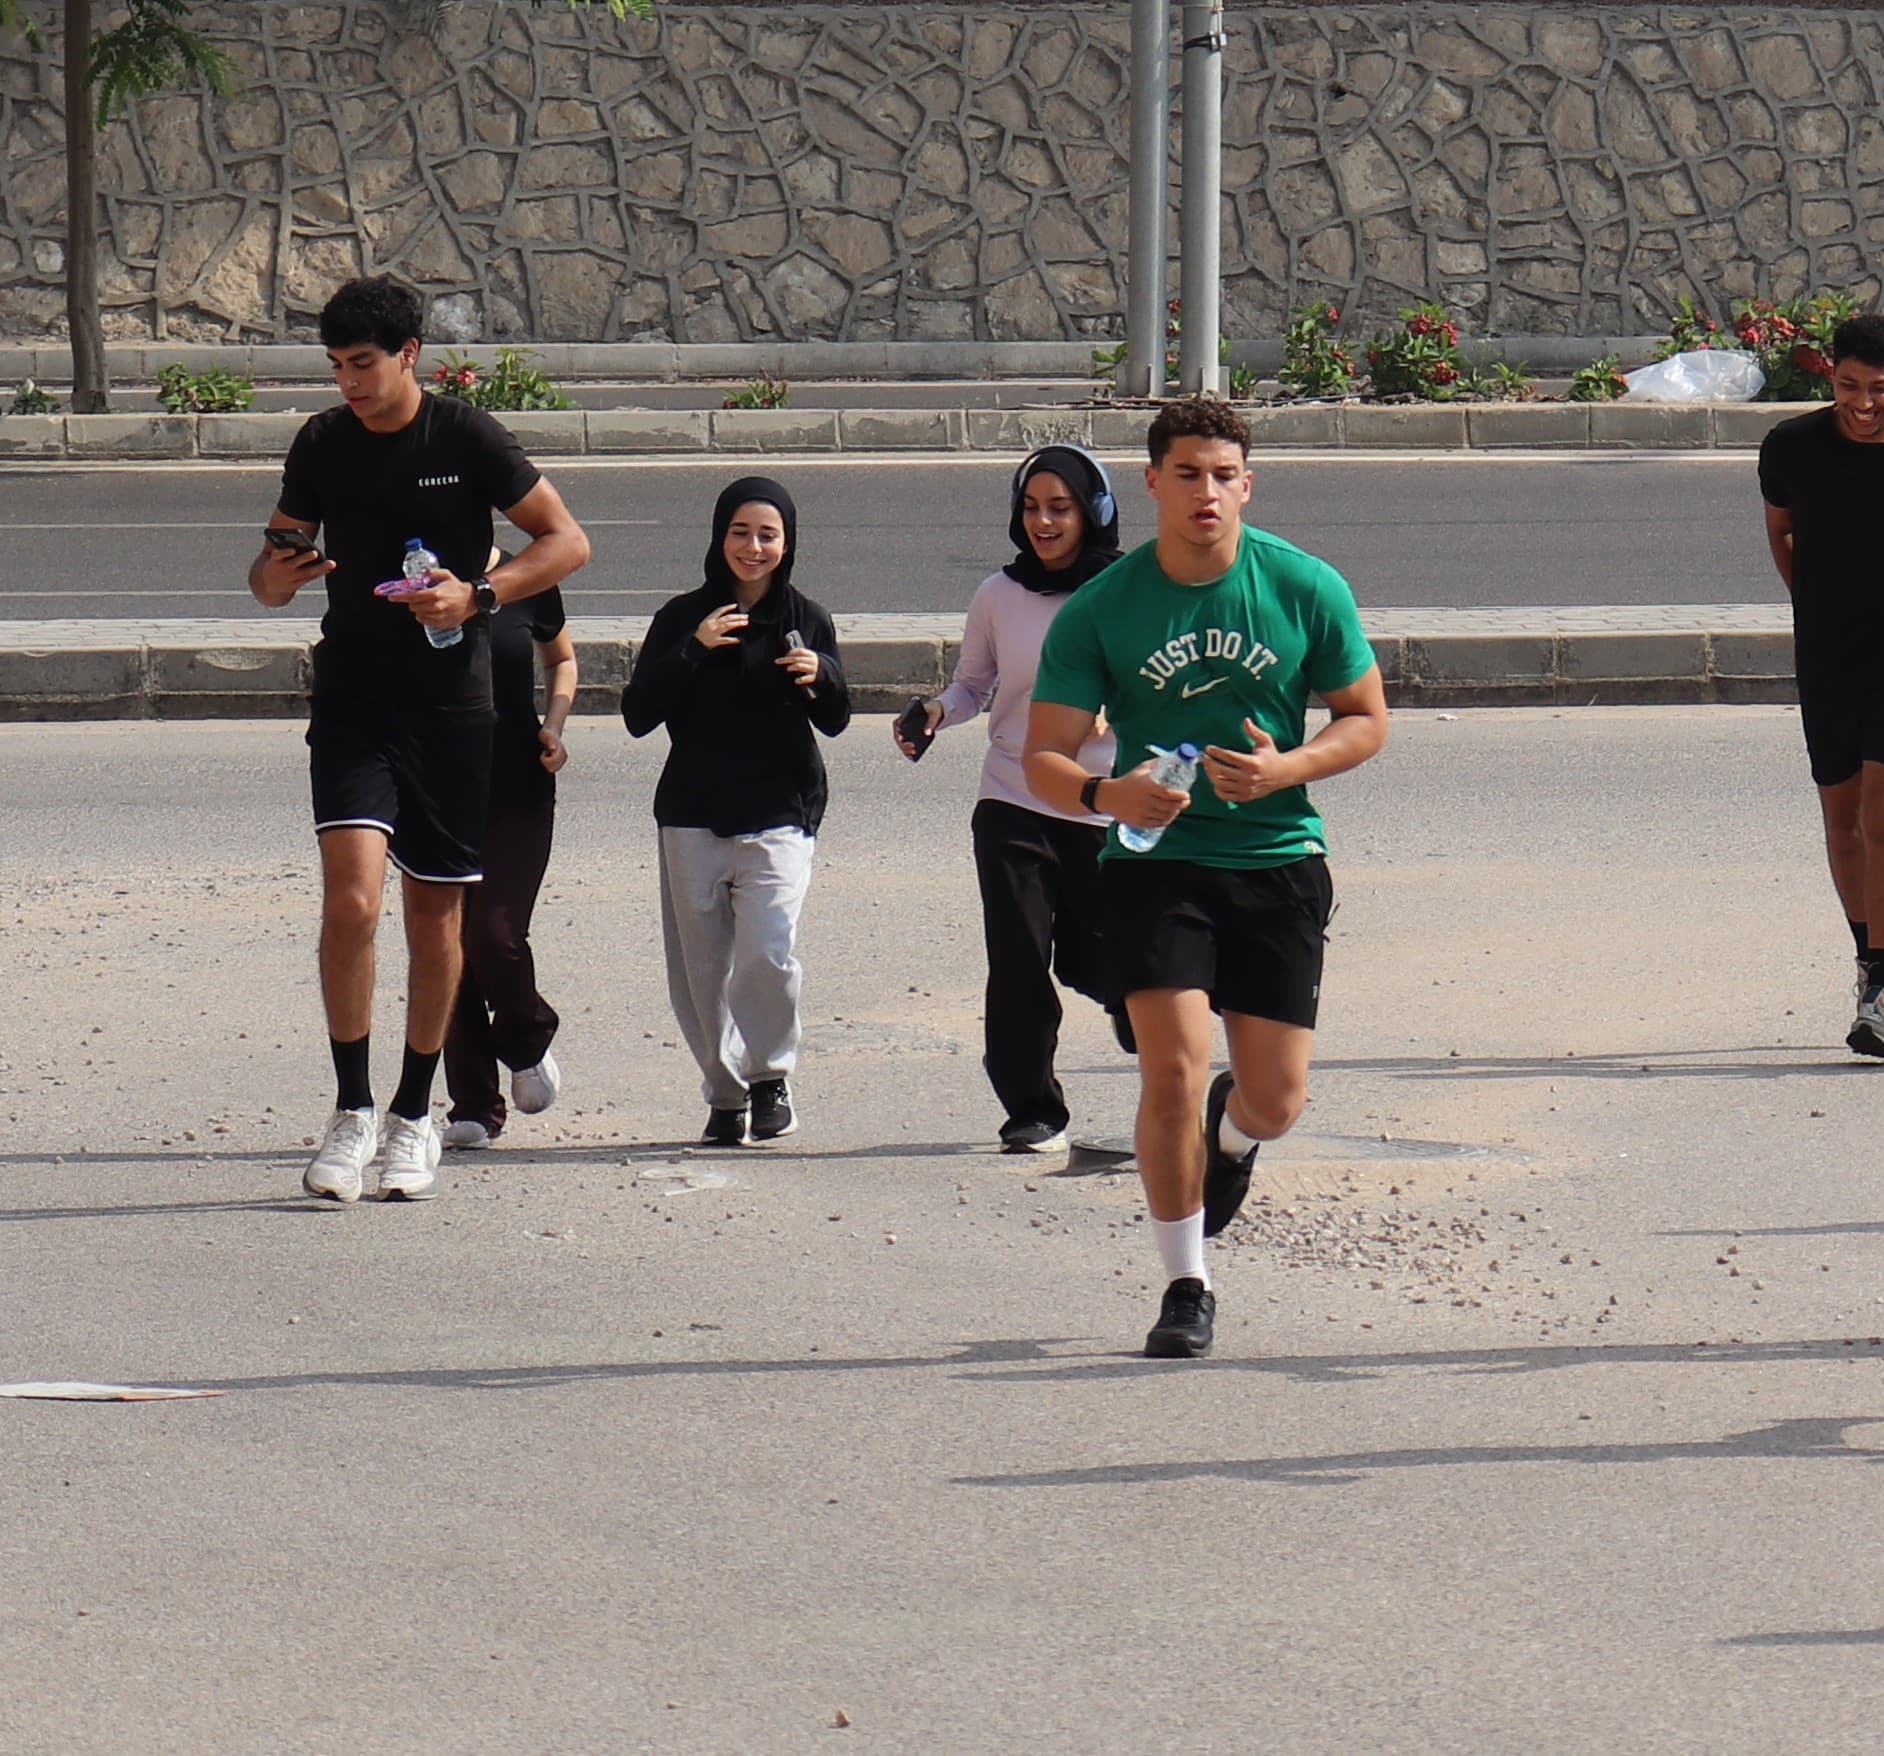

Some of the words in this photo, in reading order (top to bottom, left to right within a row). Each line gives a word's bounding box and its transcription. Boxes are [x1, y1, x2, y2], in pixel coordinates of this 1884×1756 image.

[1138, 632, 1200, 690] JUST
[1204, 628, 1242, 660] DO
[1241, 642, 1279, 681] IT.
